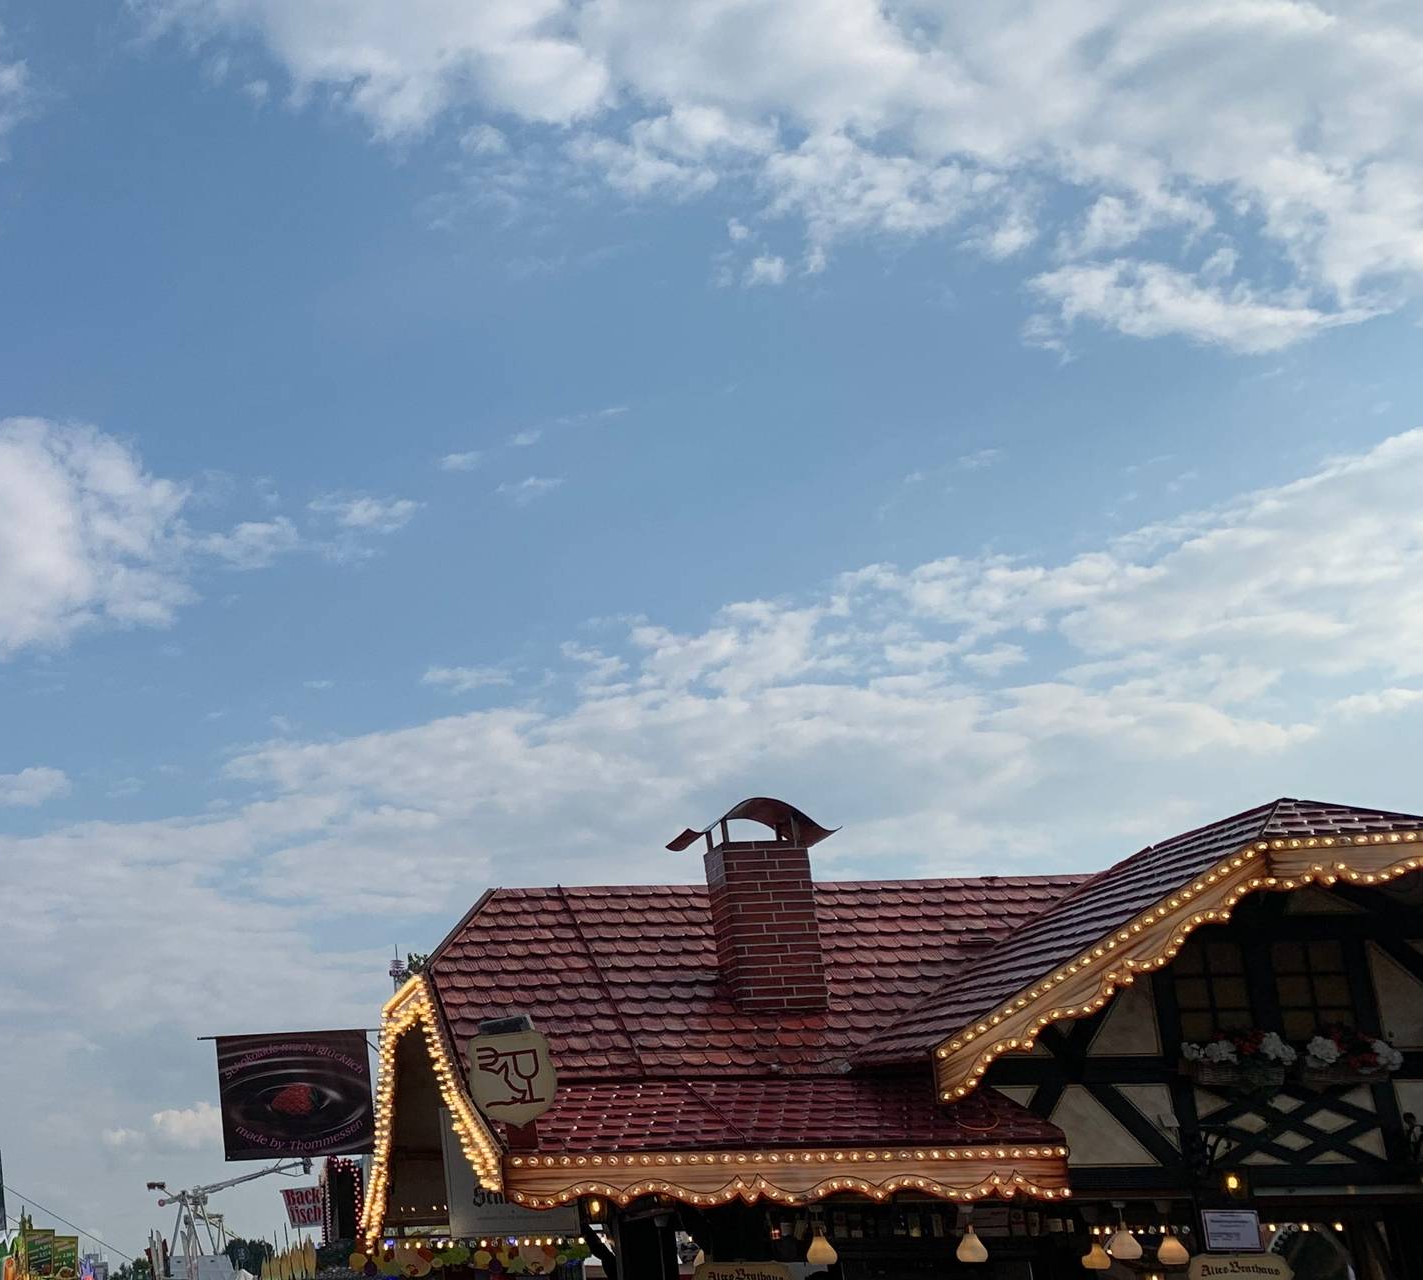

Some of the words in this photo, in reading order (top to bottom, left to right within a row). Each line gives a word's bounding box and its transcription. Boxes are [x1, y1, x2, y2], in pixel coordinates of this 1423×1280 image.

[316, 1045, 364, 1075] glücklich
[236, 1126, 268, 1145] made
[269, 1137, 285, 1150] by
[289, 1119, 364, 1151] Thommessen
[285, 1188, 322, 1206] Back
[1201, 1264, 1230, 1277] Altes
